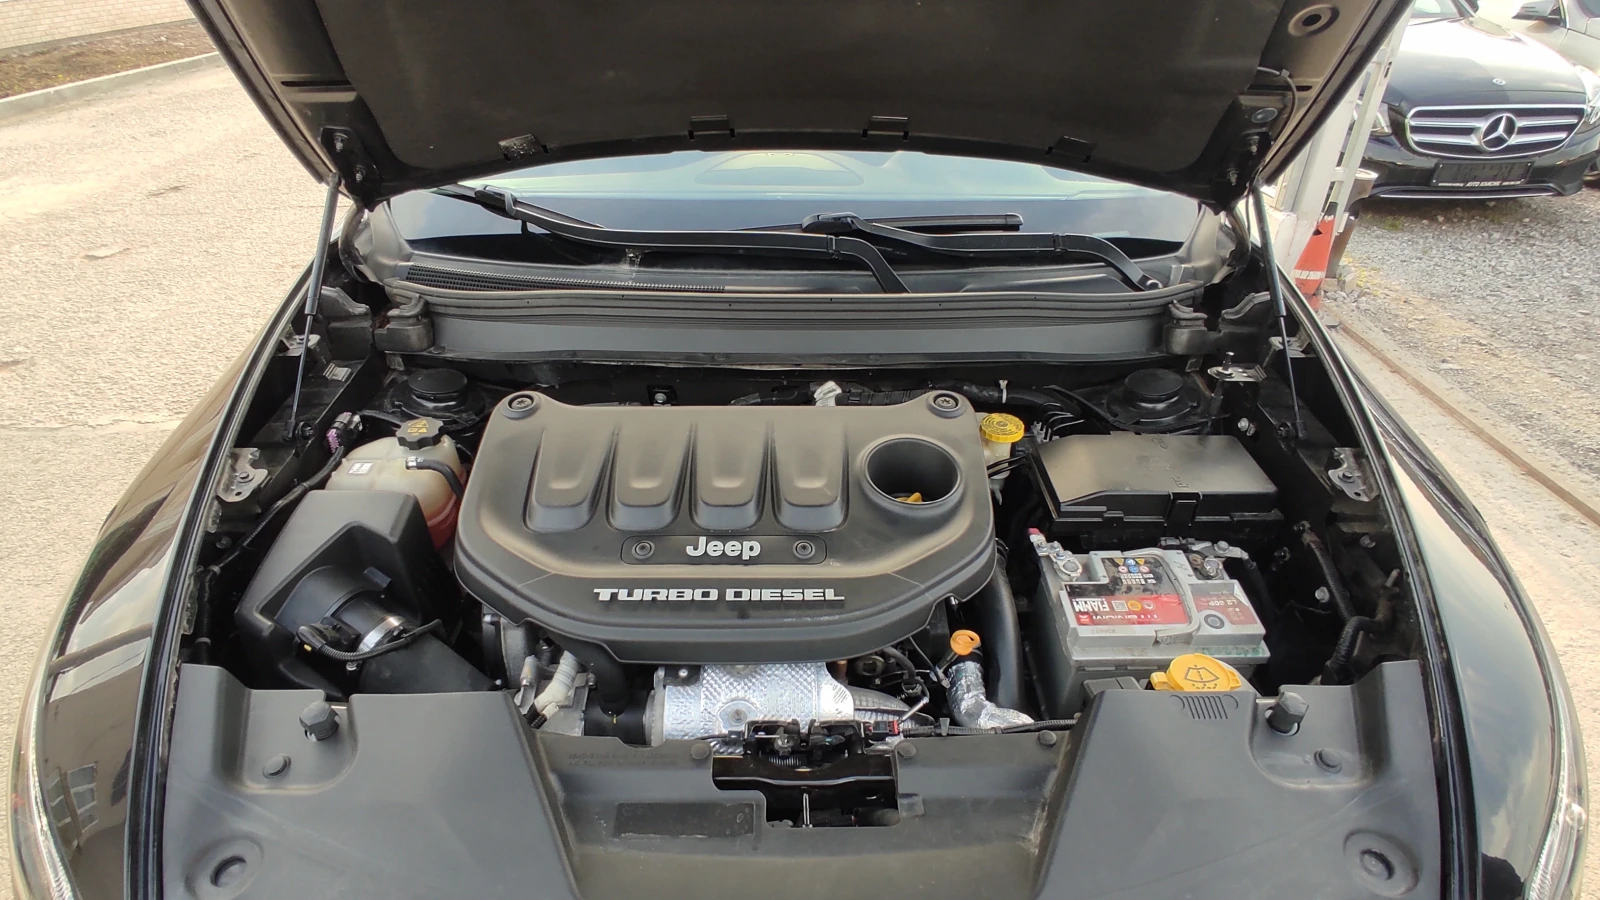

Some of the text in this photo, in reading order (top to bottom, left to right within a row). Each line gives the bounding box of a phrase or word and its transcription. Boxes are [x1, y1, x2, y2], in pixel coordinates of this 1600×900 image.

[686, 537, 761, 560] Jeep
[594, 588, 845, 601] TURBO DIESEL
[1072, 600, 1110, 611] FIAMM
